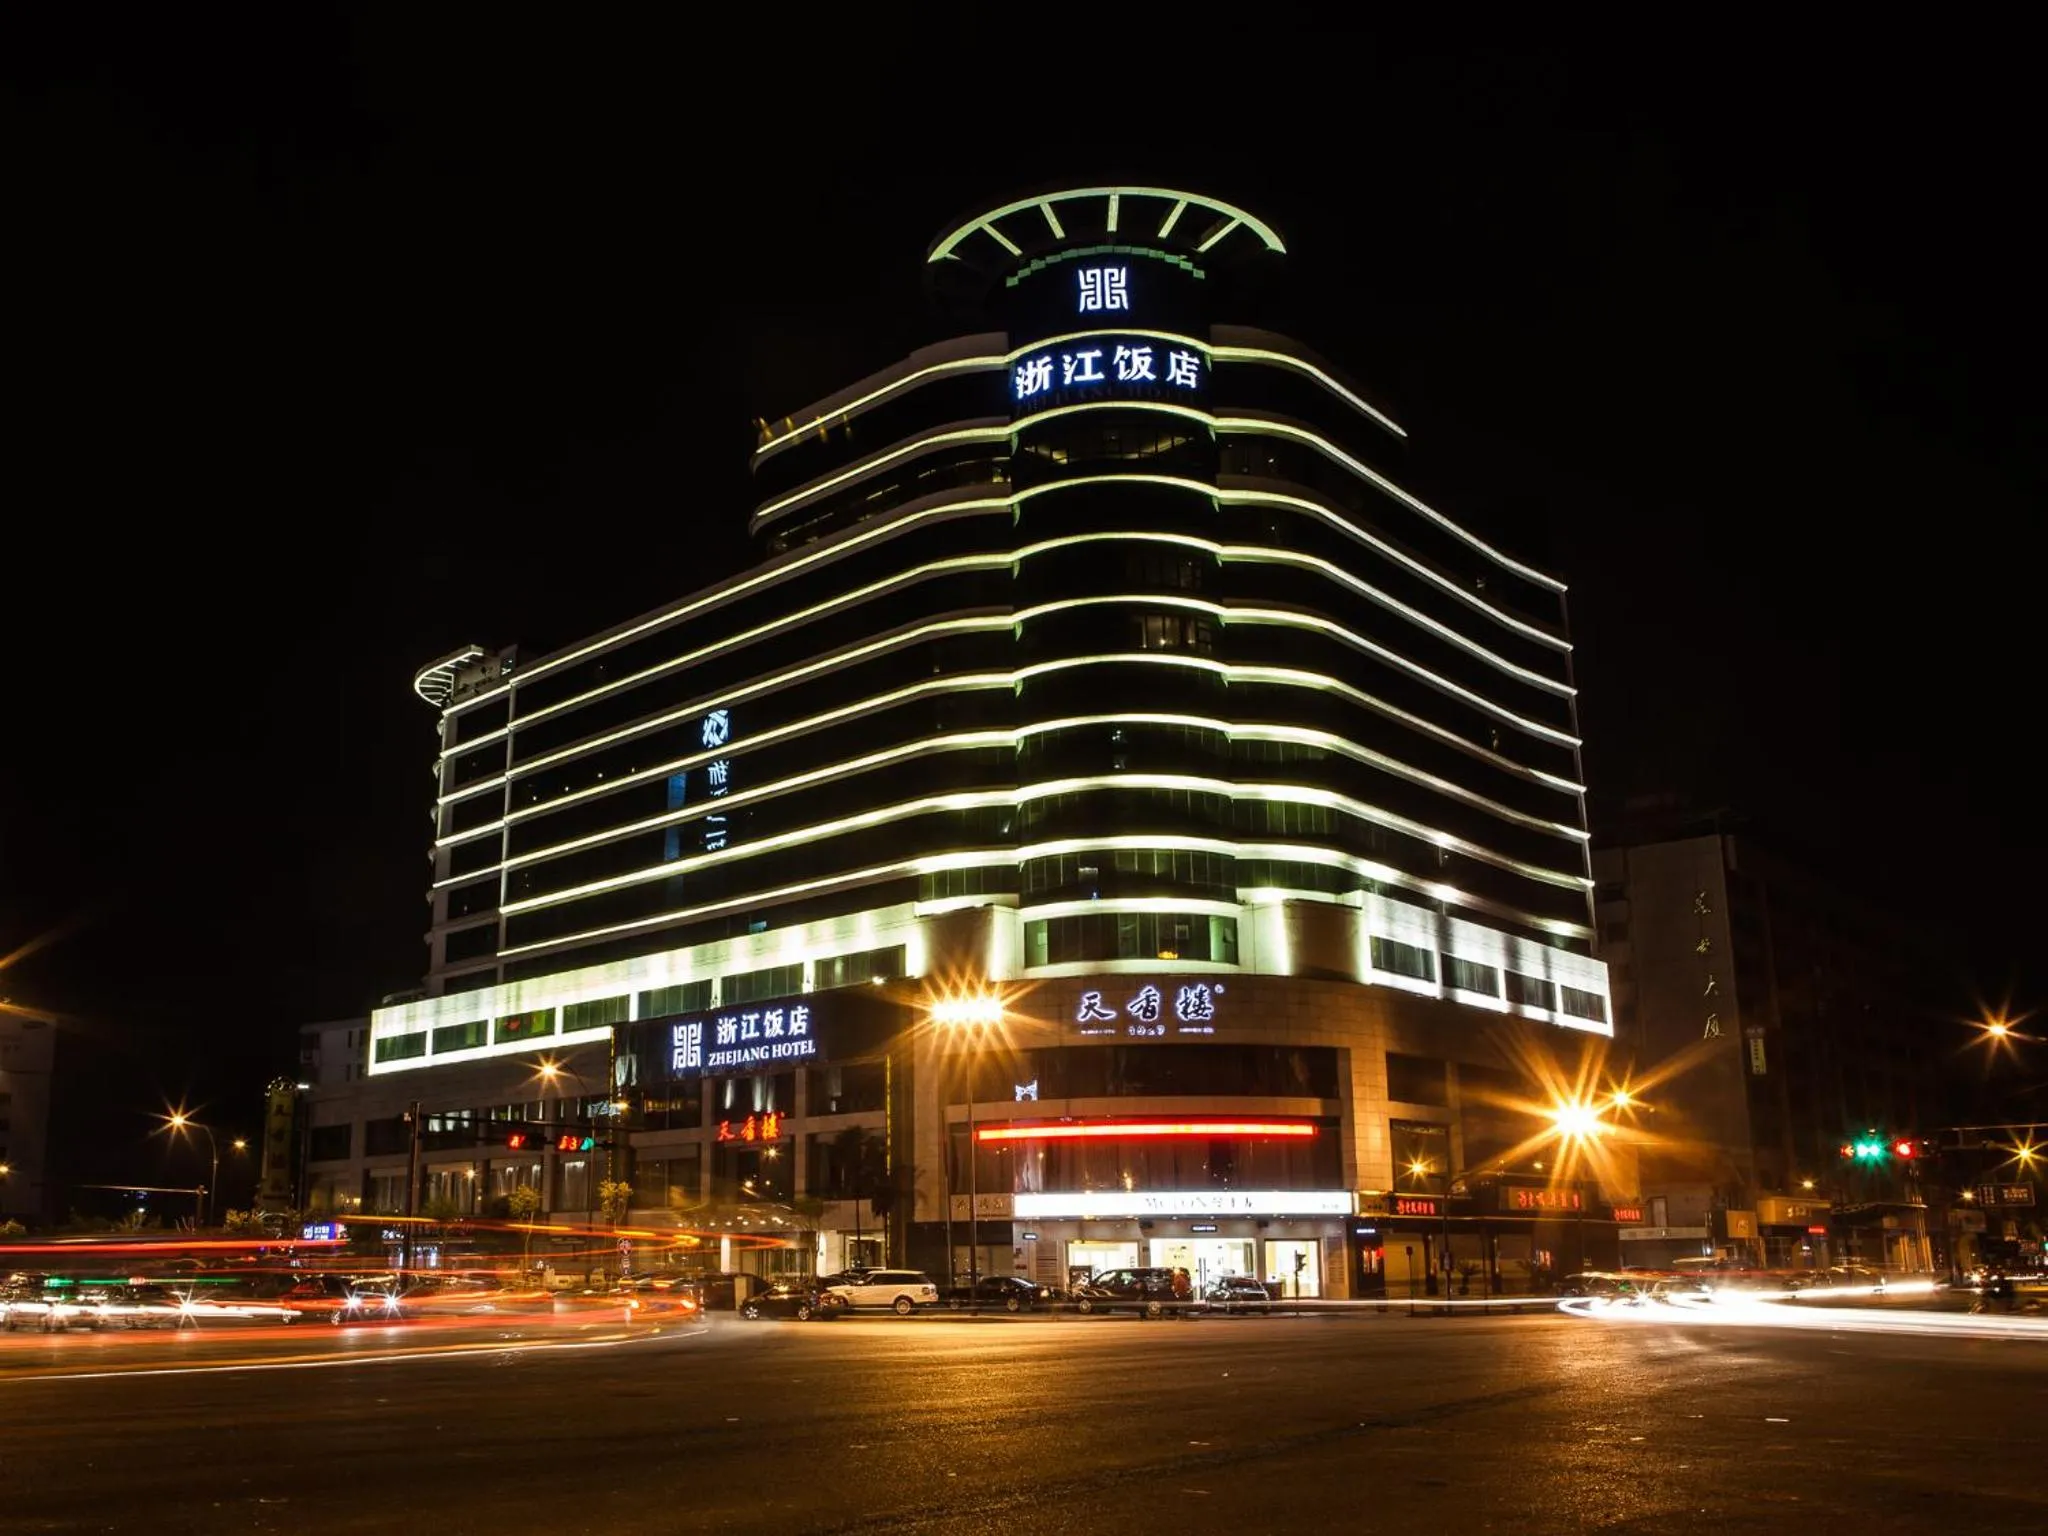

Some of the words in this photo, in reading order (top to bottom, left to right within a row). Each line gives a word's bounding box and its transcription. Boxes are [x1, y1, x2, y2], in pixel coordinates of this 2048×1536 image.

[1015, 345, 1201, 399] 浙江饭店
[1076, 984, 1215, 1021] 天香楼
[716, 1005, 809, 1045] 浙江饭店
[708, 1045, 770, 1067] ZHEJIANG
[772, 1039, 816, 1058] HOTEL
